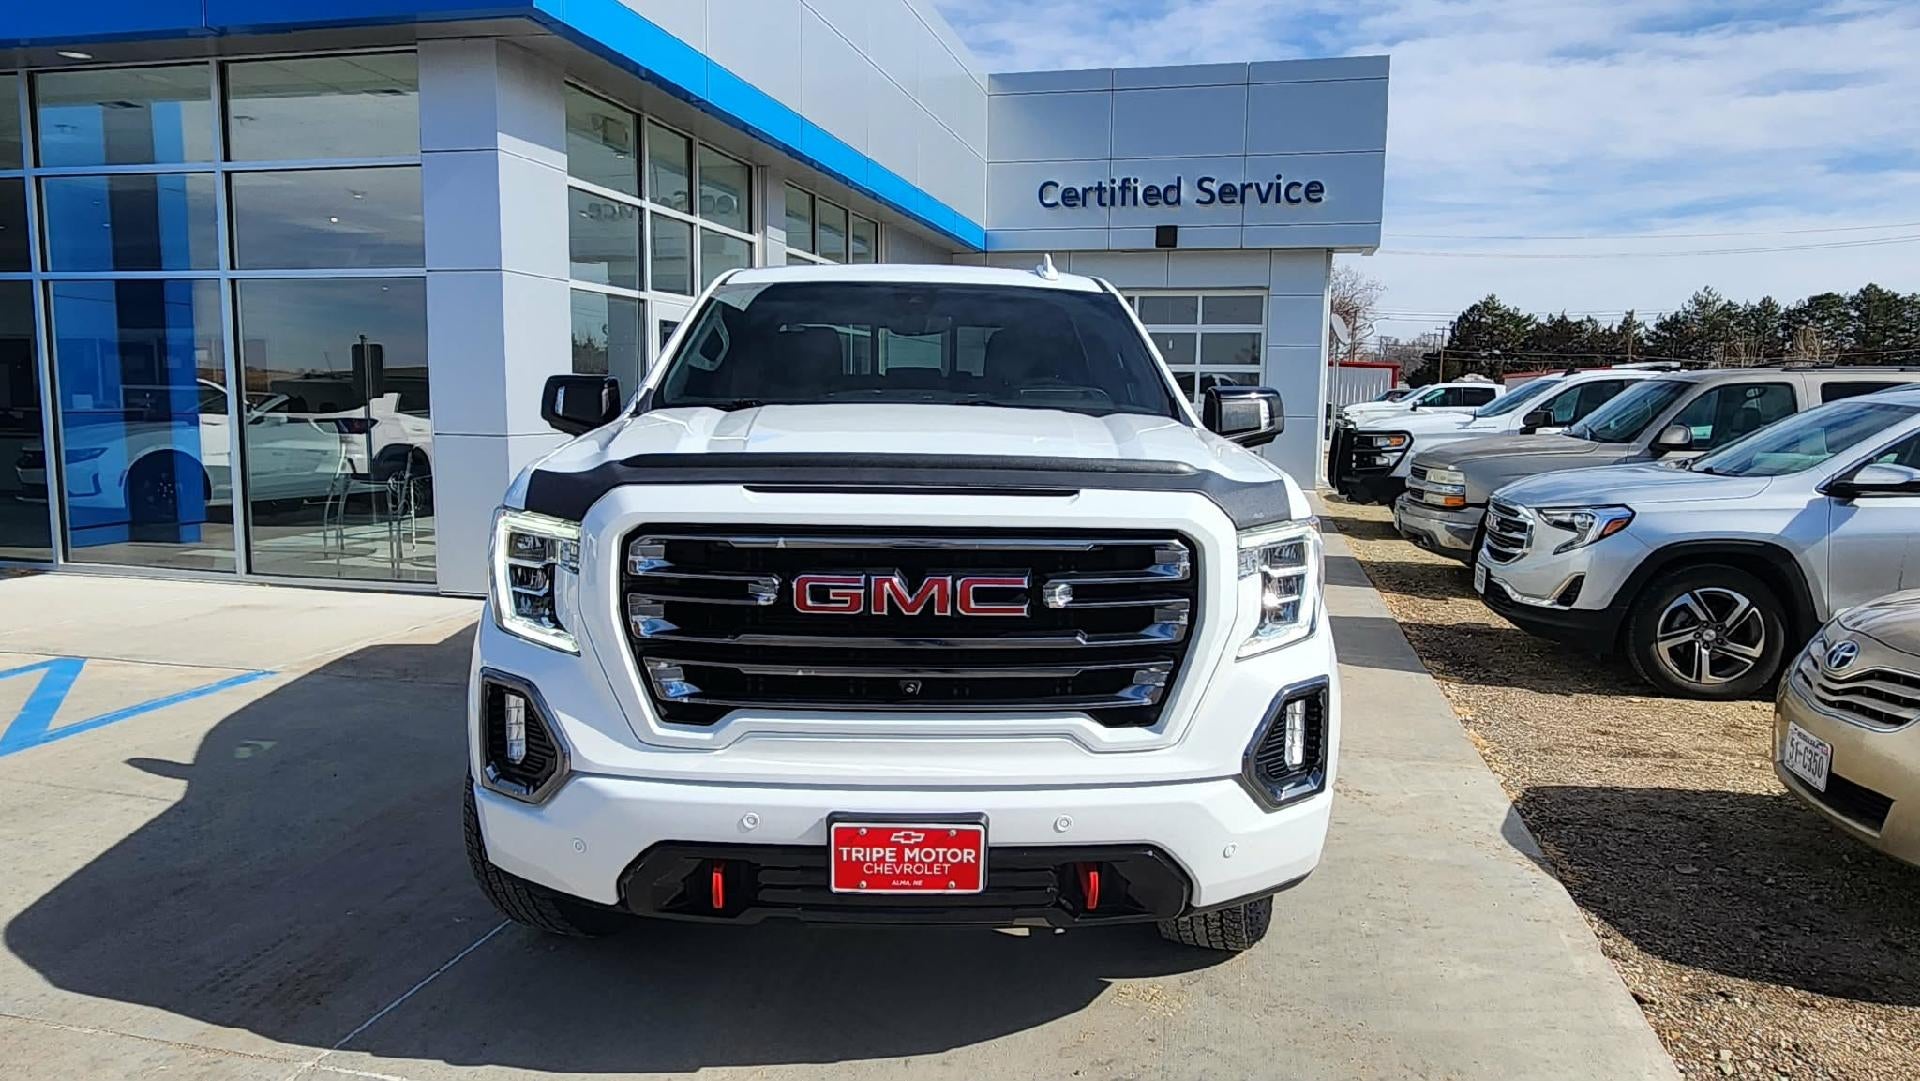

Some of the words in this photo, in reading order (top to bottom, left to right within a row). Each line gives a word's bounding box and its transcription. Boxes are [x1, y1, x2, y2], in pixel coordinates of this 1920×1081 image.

[1038, 176, 1181, 208] Certified
[1195, 173, 1325, 205] Service
[793, 573, 1030, 616] GMC
[839, 847, 897, 862] TRIPE
[904, 847, 976, 864] MOTOR
[863, 862, 951, 875] CHEVROLET
